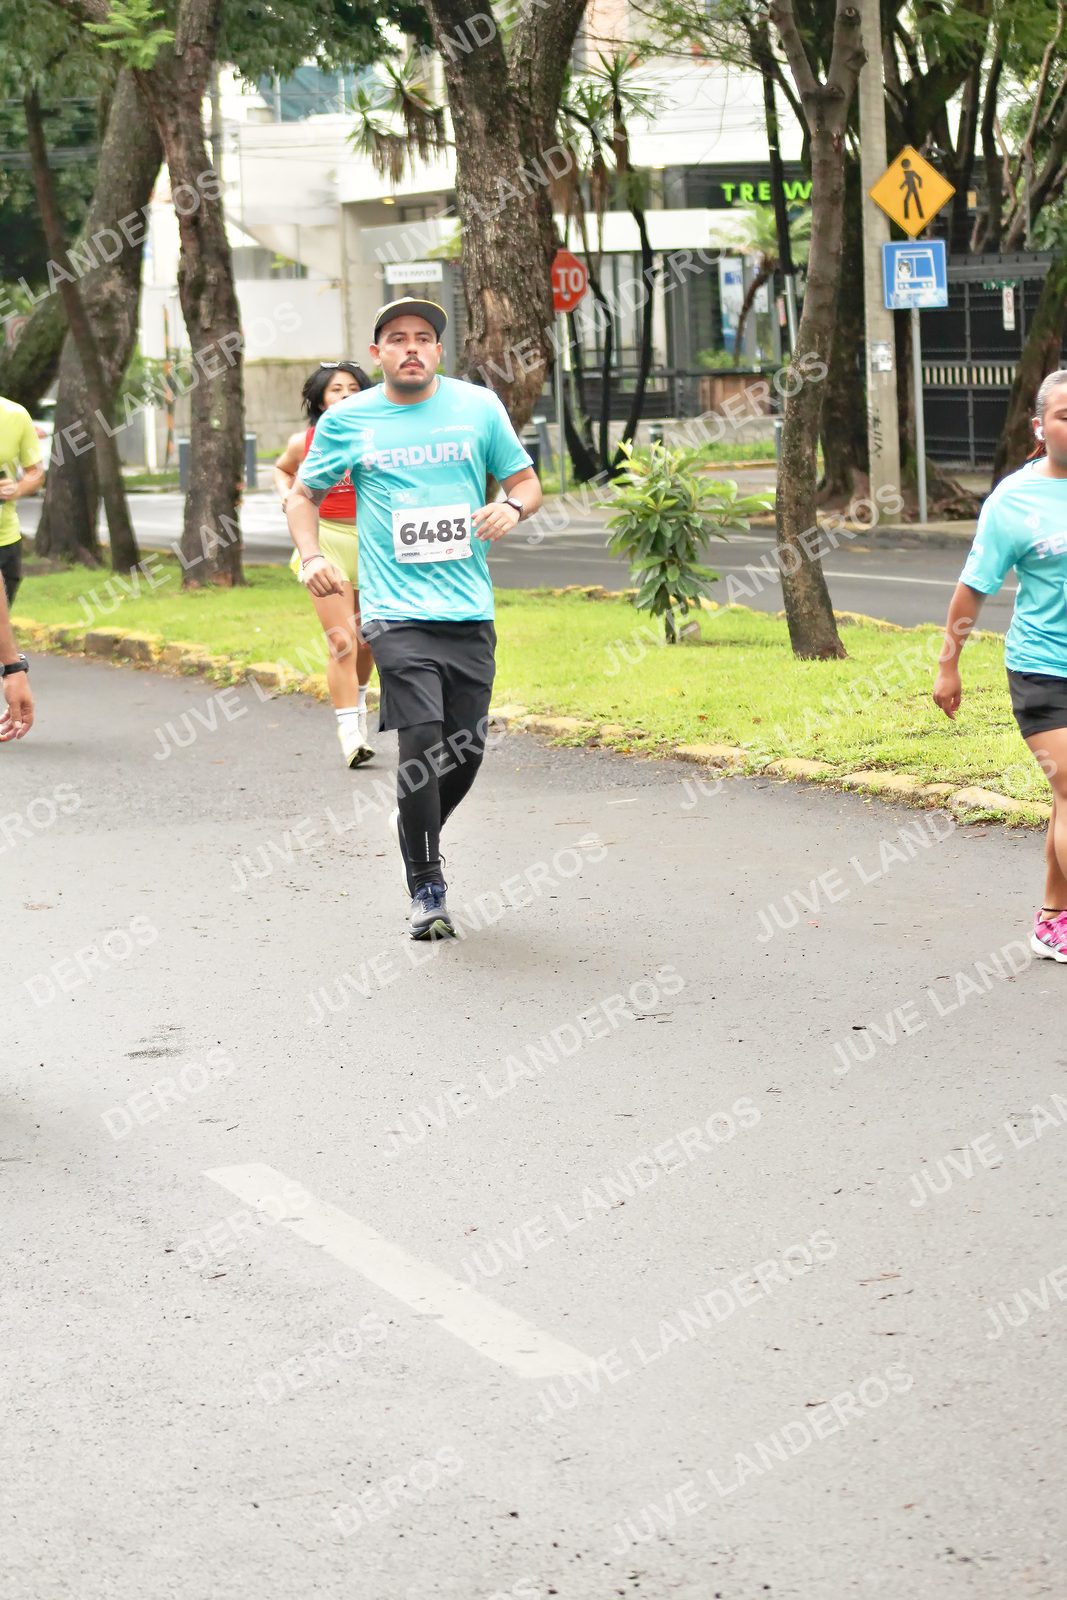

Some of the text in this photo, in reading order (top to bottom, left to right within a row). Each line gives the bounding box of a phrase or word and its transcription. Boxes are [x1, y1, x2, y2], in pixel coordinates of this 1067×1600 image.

[553, 268, 584, 293] TO
[361, 441, 473, 470] PERDURA
[400, 518, 467, 545] 6483
